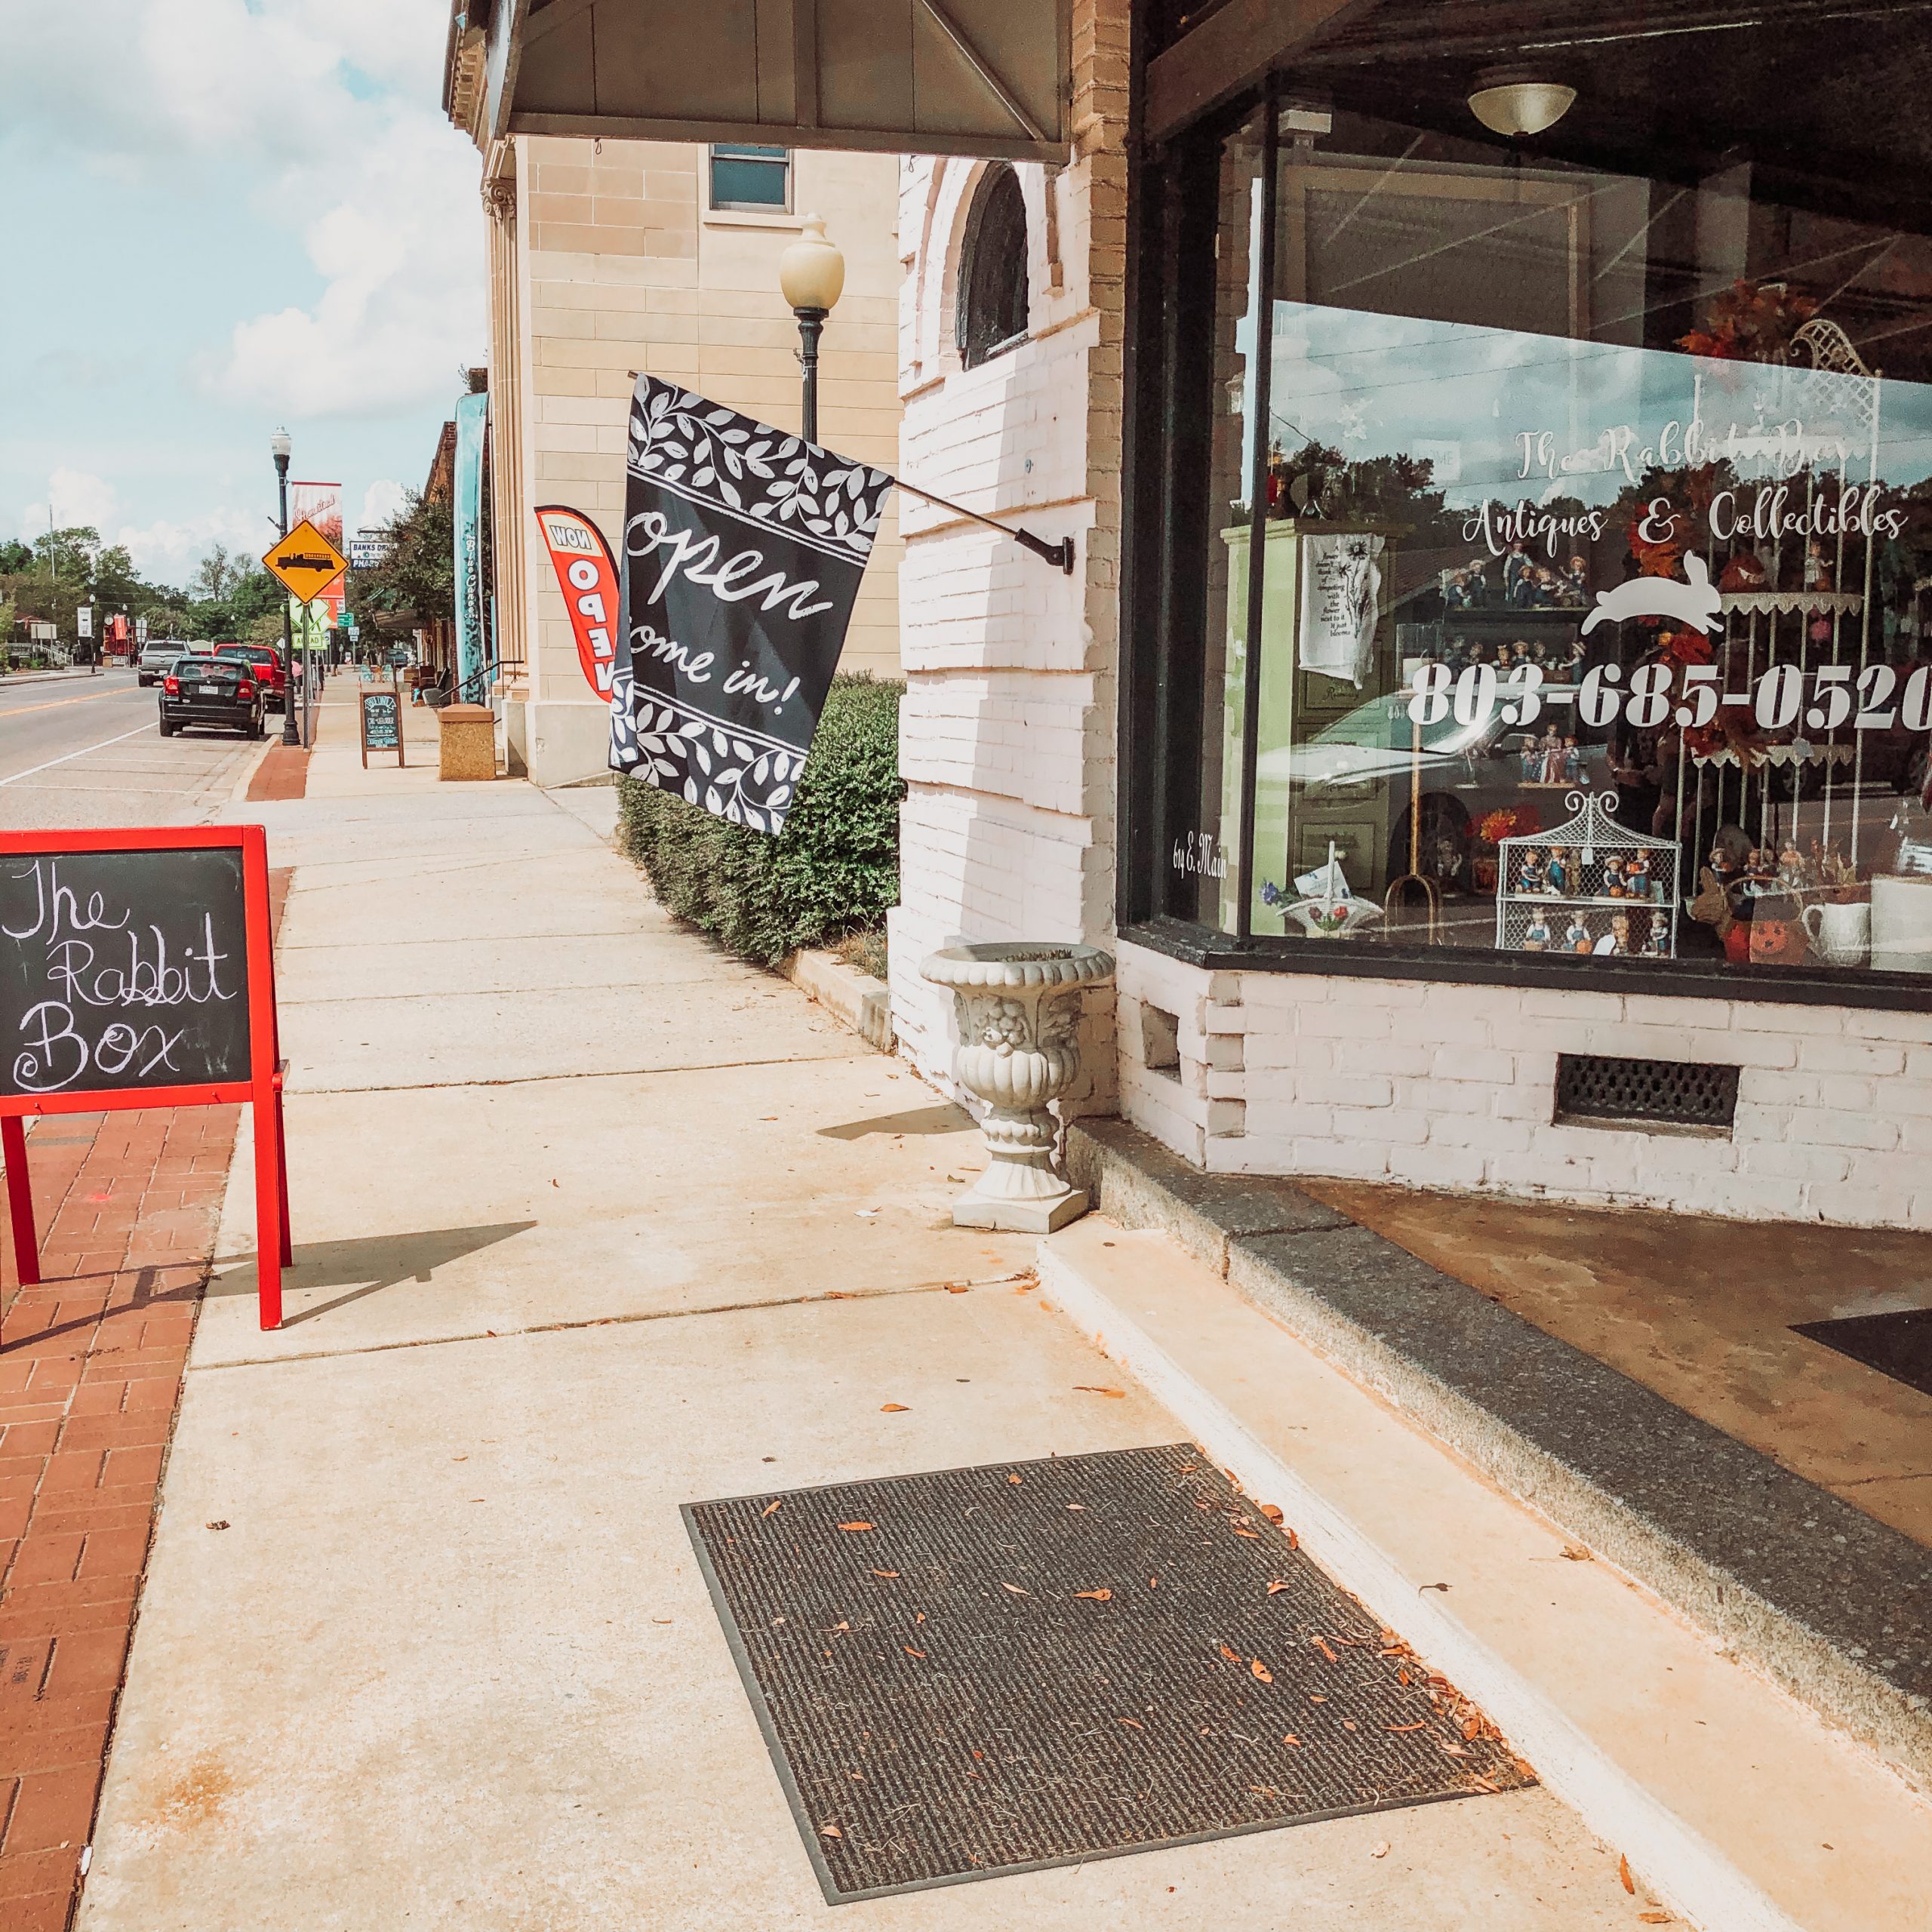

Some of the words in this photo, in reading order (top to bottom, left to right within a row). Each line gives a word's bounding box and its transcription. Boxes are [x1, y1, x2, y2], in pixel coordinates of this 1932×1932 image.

[466, 540, 475, 574] Blue
[1463, 498, 1608, 557] Antiques
[1638, 497, 1681, 543] &
[1709, 485, 1908, 542] Collectibles
[466, 574, 477, 613] Canoe
[629, 616, 715, 682] ome
[723, 661, 800, 715] in!
[1407, 663, 1932, 731] 803-685-0520
[1186, 830, 1195, 872] E.
[1197, 832, 1226, 879] Main
[2, 860, 131, 945] The
[46, 912, 238, 1007] Rabbit
[13, 1001, 184, 1092] Box
